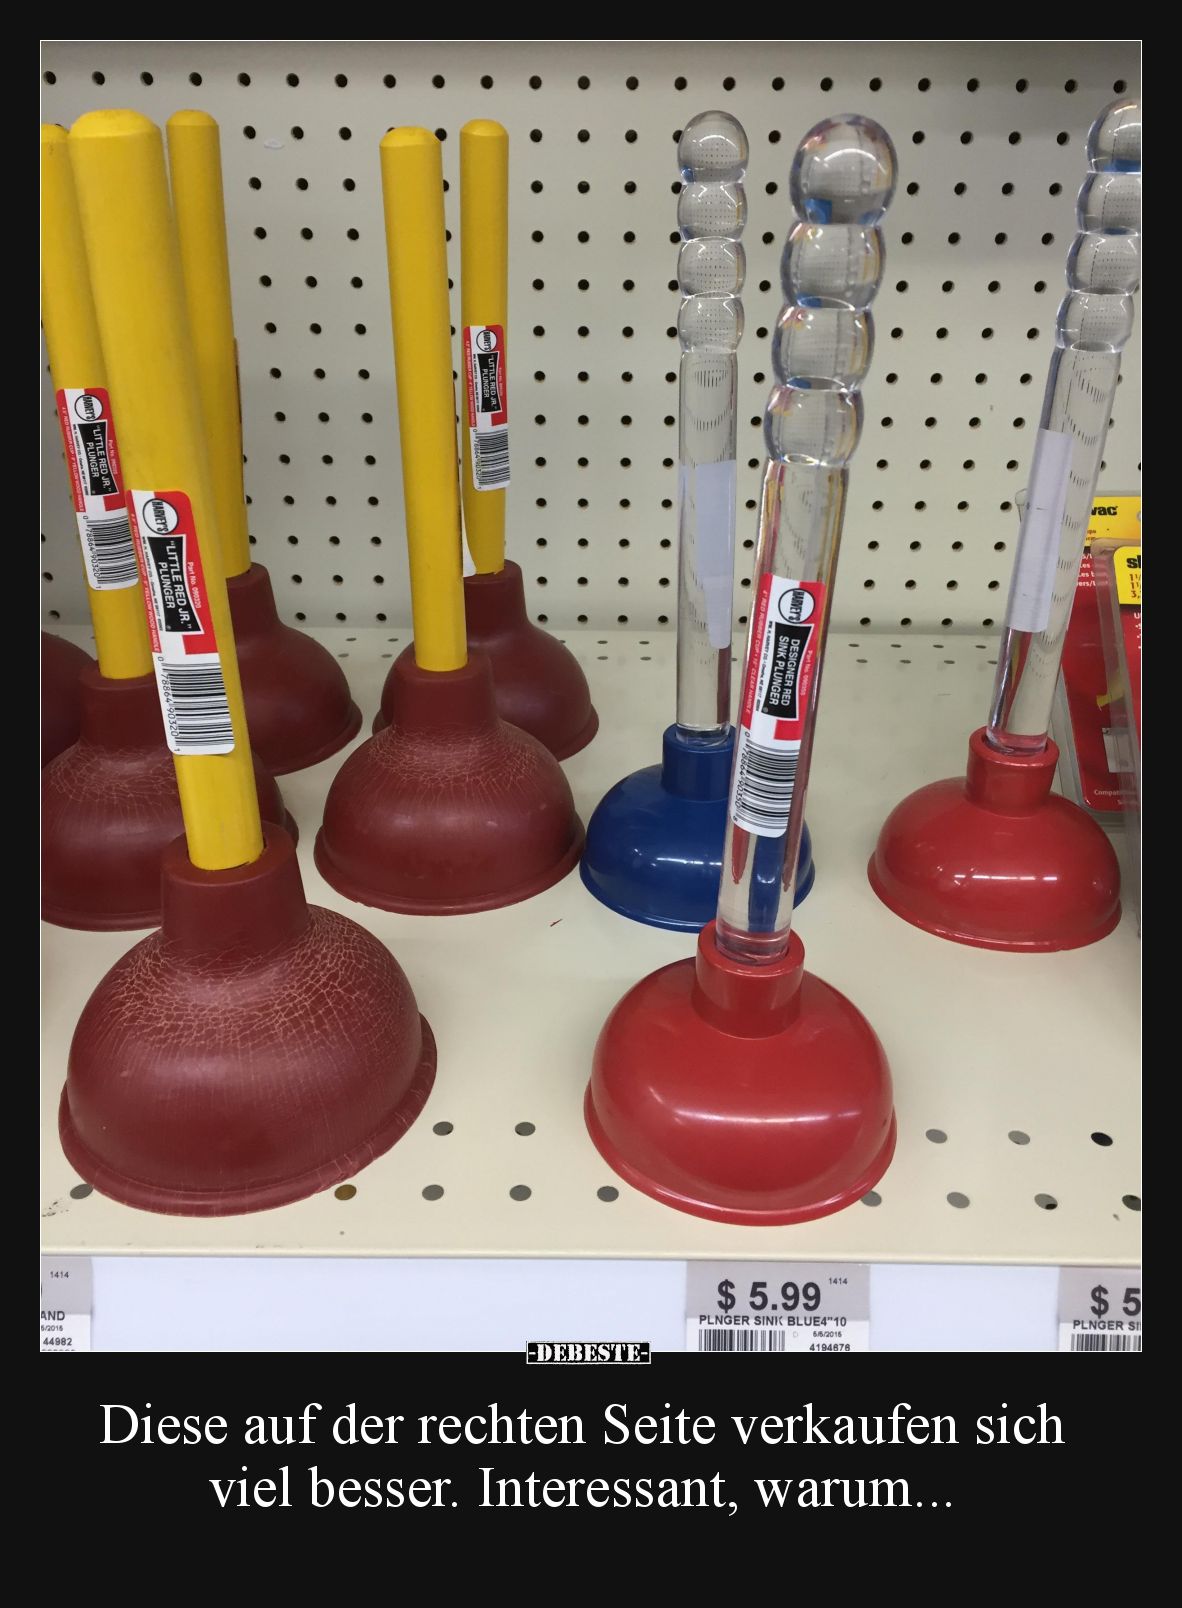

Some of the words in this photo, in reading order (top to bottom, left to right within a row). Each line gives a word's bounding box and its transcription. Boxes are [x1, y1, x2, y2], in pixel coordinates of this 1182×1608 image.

[481, 368, 490, 398] PLUNGER
[92, 425, 105, 456] "LITTLE
[86, 441, 100, 478] PLUNGER
[98, 458, 108, 474] RED
[151, 500, 169, 534] HARVEY'S
[90, 554, 101, 578] 90320
[164, 540, 182, 582] "LITTLE
[187, 561, 196, 575] Part
[158, 561, 176, 609] PLUNGER
[173, 583, 187, 606] RED
[178, 607, 192, 630] JR."
[787, 590, 805, 622] HARVEY'S
[776, 635, 790, 658] SINK
[783, 639, 800, 686] DESIGNER
[160, 674, 174, 703] 78864
[749, 668, 757, 689] CLEAR
[768, 660, 786, 706] PLUNGER
[780, 688, 792, 706] RED
[166, 707, 179, 737] 90320
[738, 748, 750, 776] 78864
[733, 779, 745, 808] 90350
[829, 1277, 848, 1285] 1414
[717, 1279, 736, 1313] $
[749, 1281, 821, 1312] 5.99
[1091, 1284, 1109, 1319] $
[699, 1315, 750, 1326] PLNGER
[753, 1316, 783, 1326] SINK
[787, 1316, 847, 1327] BLUE4"10
[1073, 1320, 1124, 1330] PLNGER
[43, 1337, 73, 1347] 44982
